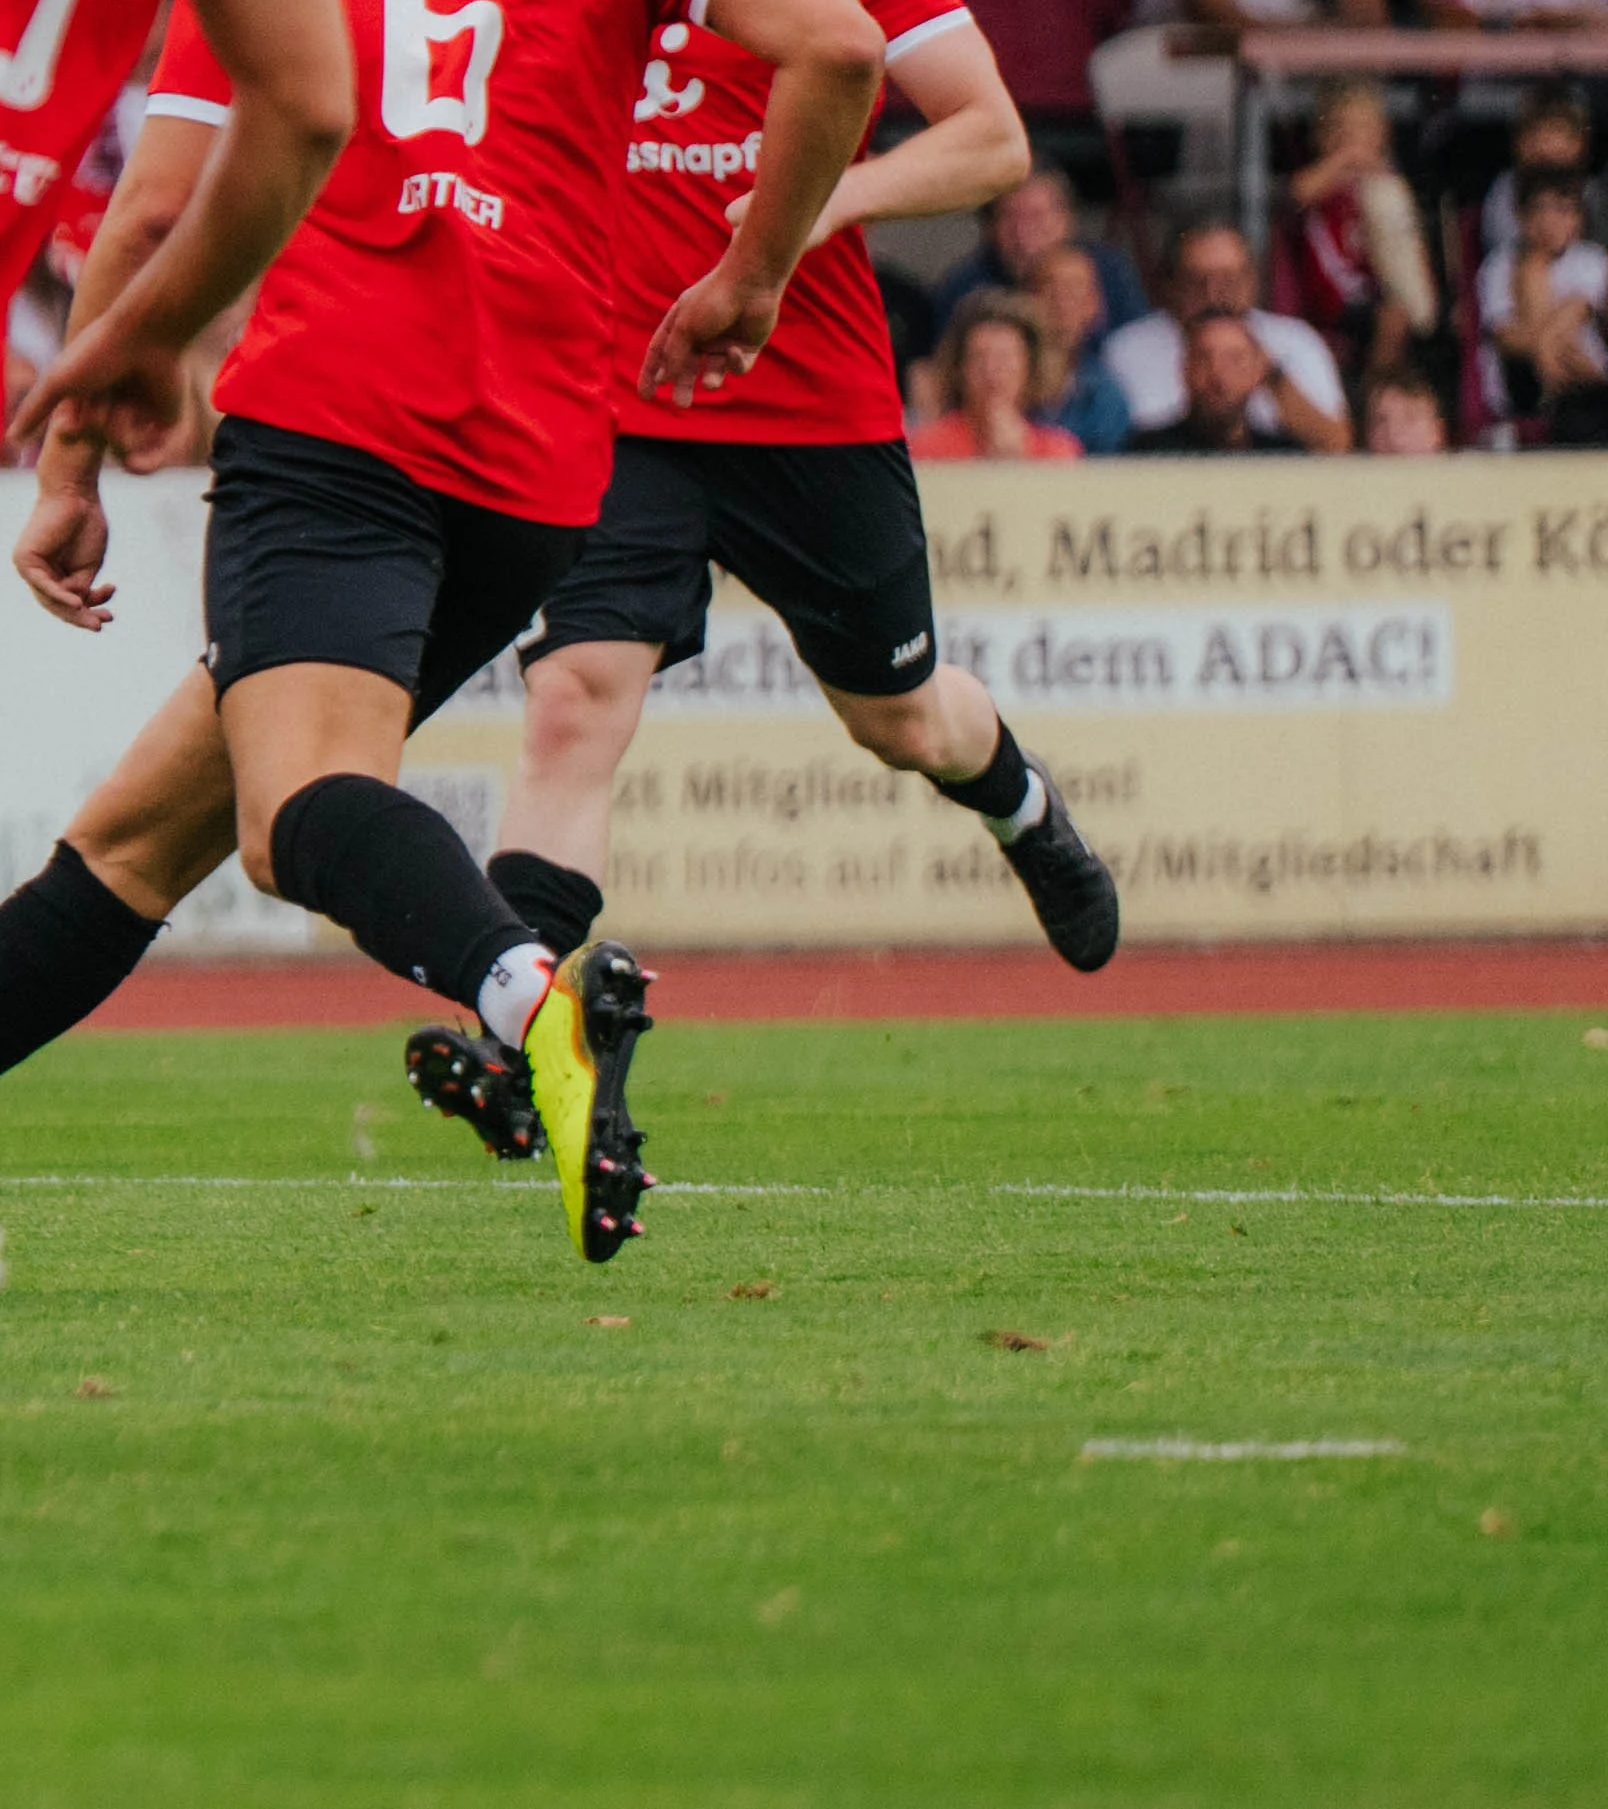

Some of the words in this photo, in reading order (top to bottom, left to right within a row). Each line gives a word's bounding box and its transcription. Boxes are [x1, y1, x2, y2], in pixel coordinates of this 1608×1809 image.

[1046, 506, 1323, 584] Madrid
[1342, 503, 1507, 577] oder
[1011, 618, 1175, 690] dem
[1195, 615, 1440, 691] ADAC!
[682, 755, 898, 821] Mitglied
